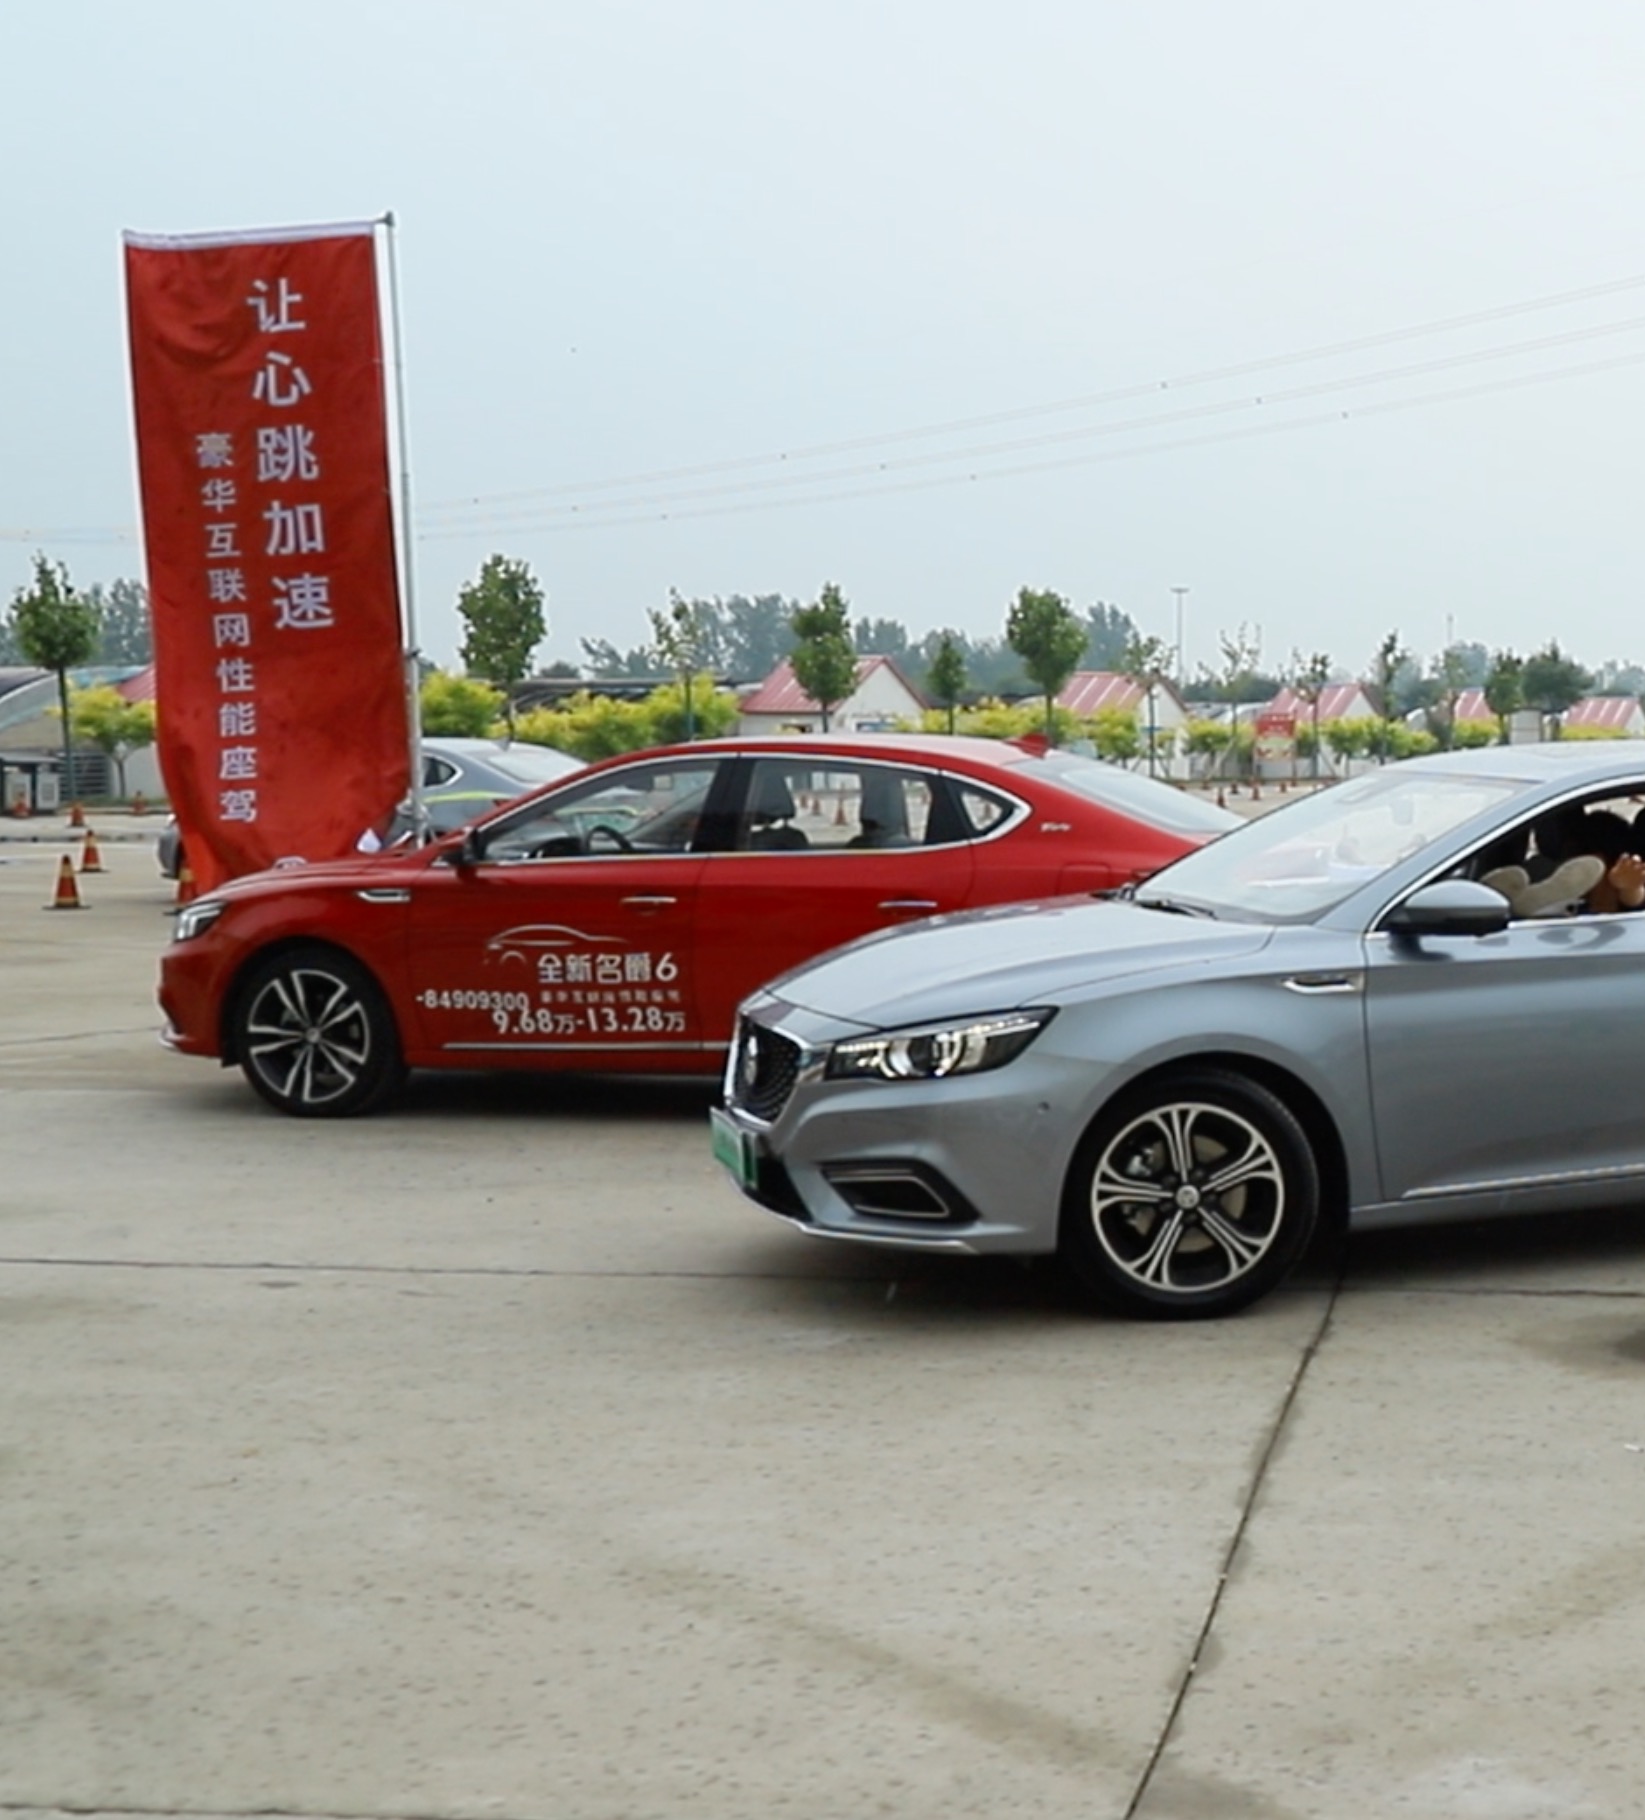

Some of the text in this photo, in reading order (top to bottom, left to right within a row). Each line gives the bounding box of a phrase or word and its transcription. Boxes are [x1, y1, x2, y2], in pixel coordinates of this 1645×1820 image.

[194, 432, 258, 824] 豪华互联网性能座驾
[246, 277, 335, 631] 让心跳加速
[536, 952, 679, 985] 全新名爵6
